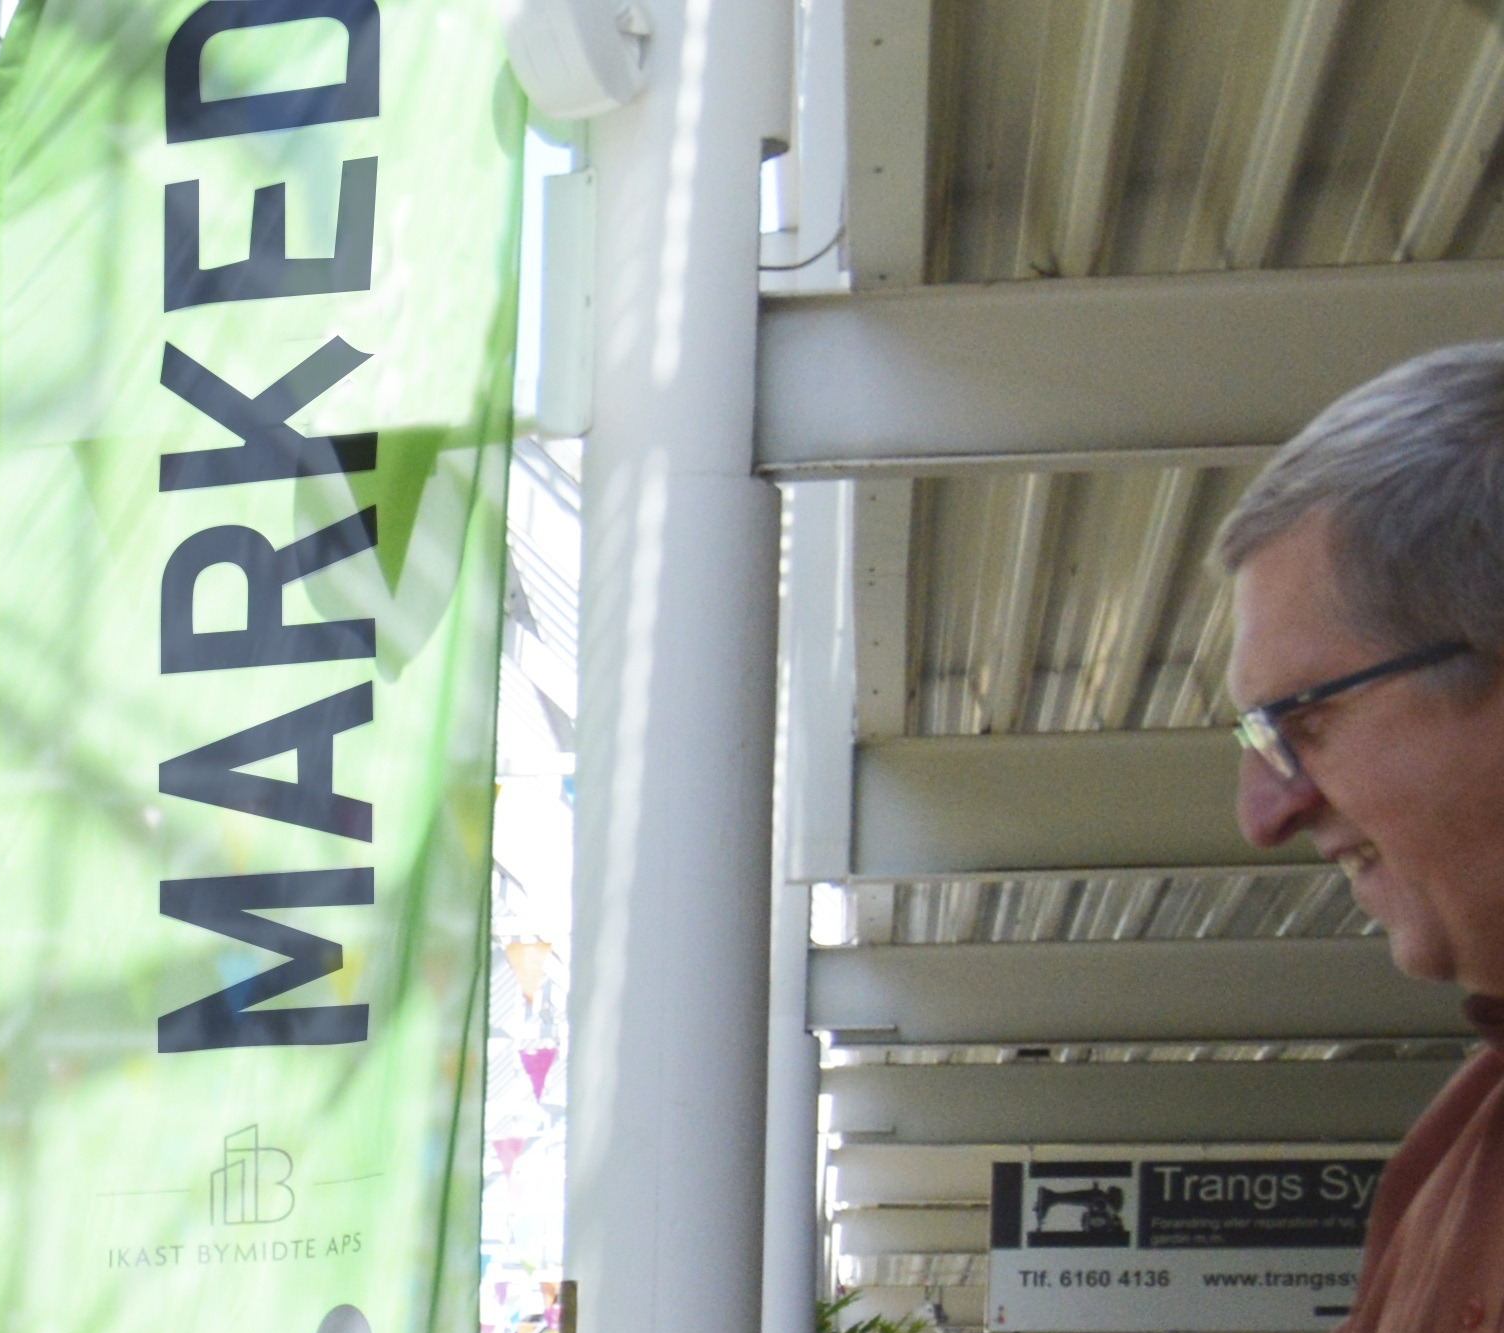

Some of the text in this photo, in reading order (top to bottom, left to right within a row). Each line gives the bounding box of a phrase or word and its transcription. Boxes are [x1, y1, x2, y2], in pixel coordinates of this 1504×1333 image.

[158, 0, 380, 1053] MARKED
[1153, 1165, 1381, 1210] Trangs Sy
[108, 1231, 363, 1269] IKAST BYMIDTE APS
[1019, 1270, 1051, 1288] Tlf.
[1059, 1269, 1111, 1288] 6160
[1117, 1269, 1170, 1288] 4136
